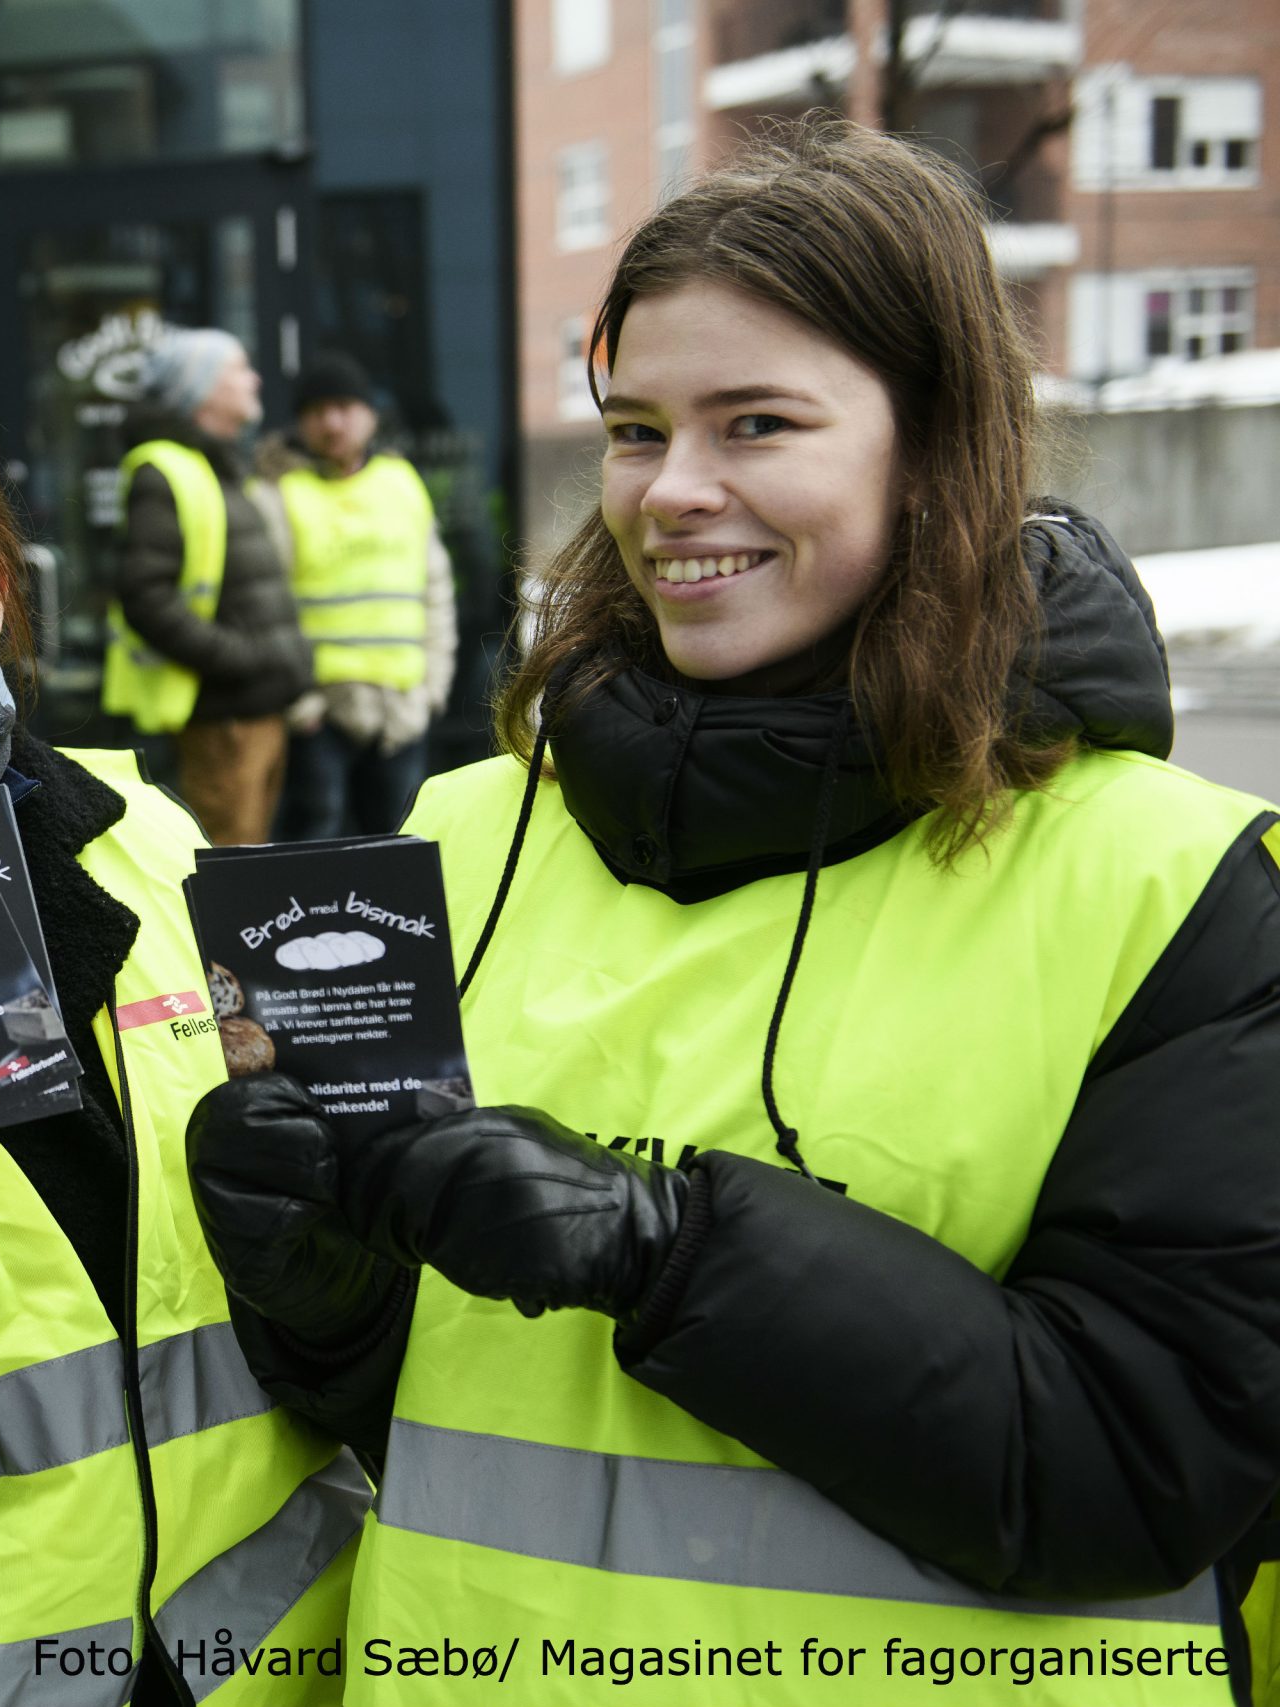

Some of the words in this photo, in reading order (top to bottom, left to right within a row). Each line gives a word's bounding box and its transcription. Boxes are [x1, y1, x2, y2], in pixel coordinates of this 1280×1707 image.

[240, 896, 306, 950] Brød
[309, 901, 338, 914] med
[345, 891, 436, 940] bismak
[256, 991, 271, 1001] På
[272, 990, 298, 1000] Godt
[299, 988, 325, 998] Brød
[332, 984, 375, 997] Nydalen
[377, 982, 391, 992] får
[394, 980, 415, 991] ikke
[261, 1006, 298, 1016] ansatte
[301, 1004, 320, 1013] den
[322, 1002, 352, 1012] lønna
[354, 1000, 367, 1009] de
[370, 998, 386, 1008] har
[388, 997, 412, 1007] krav
[265, 1021, 281, 1032] på.
[283, 1020, 294, 1029] Vi
[296, 1018, 328, 1028] krever
[388, 1013, 412, 1021] men
[291, 1033, 353, 1044] arbeidsgiver
[355, 1030, 391, 1040] nekter.
[369, 1078, 400, 1091] med
[403, 1077, 422, 1090] de
